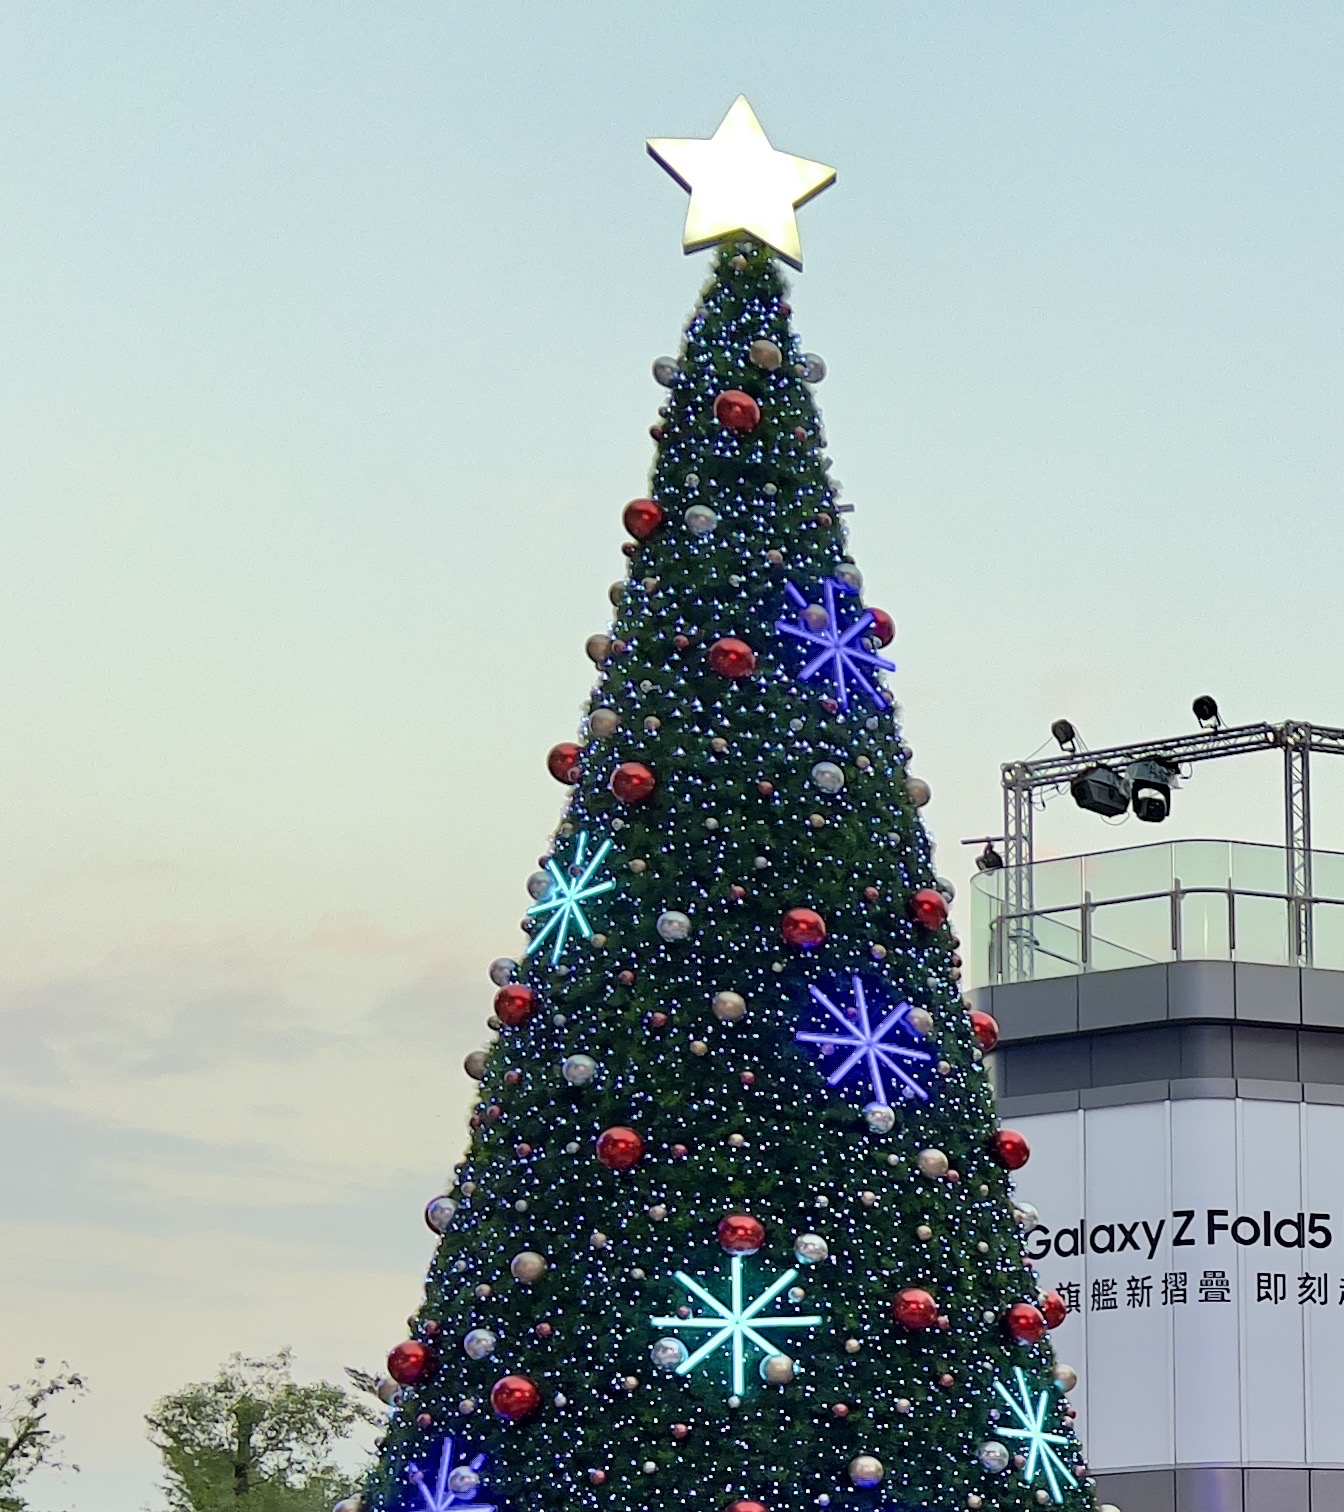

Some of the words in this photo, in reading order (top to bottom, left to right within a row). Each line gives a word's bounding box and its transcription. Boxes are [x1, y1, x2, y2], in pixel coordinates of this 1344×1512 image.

[1025, 1218, 1166, 1260] Galaxy
[1172, 1210, 1196, 1246] Z
[1207, 1209, 1332, 1249] Fold5
[1056, 1270, 1232, 1314] 旗艦新摺疊
